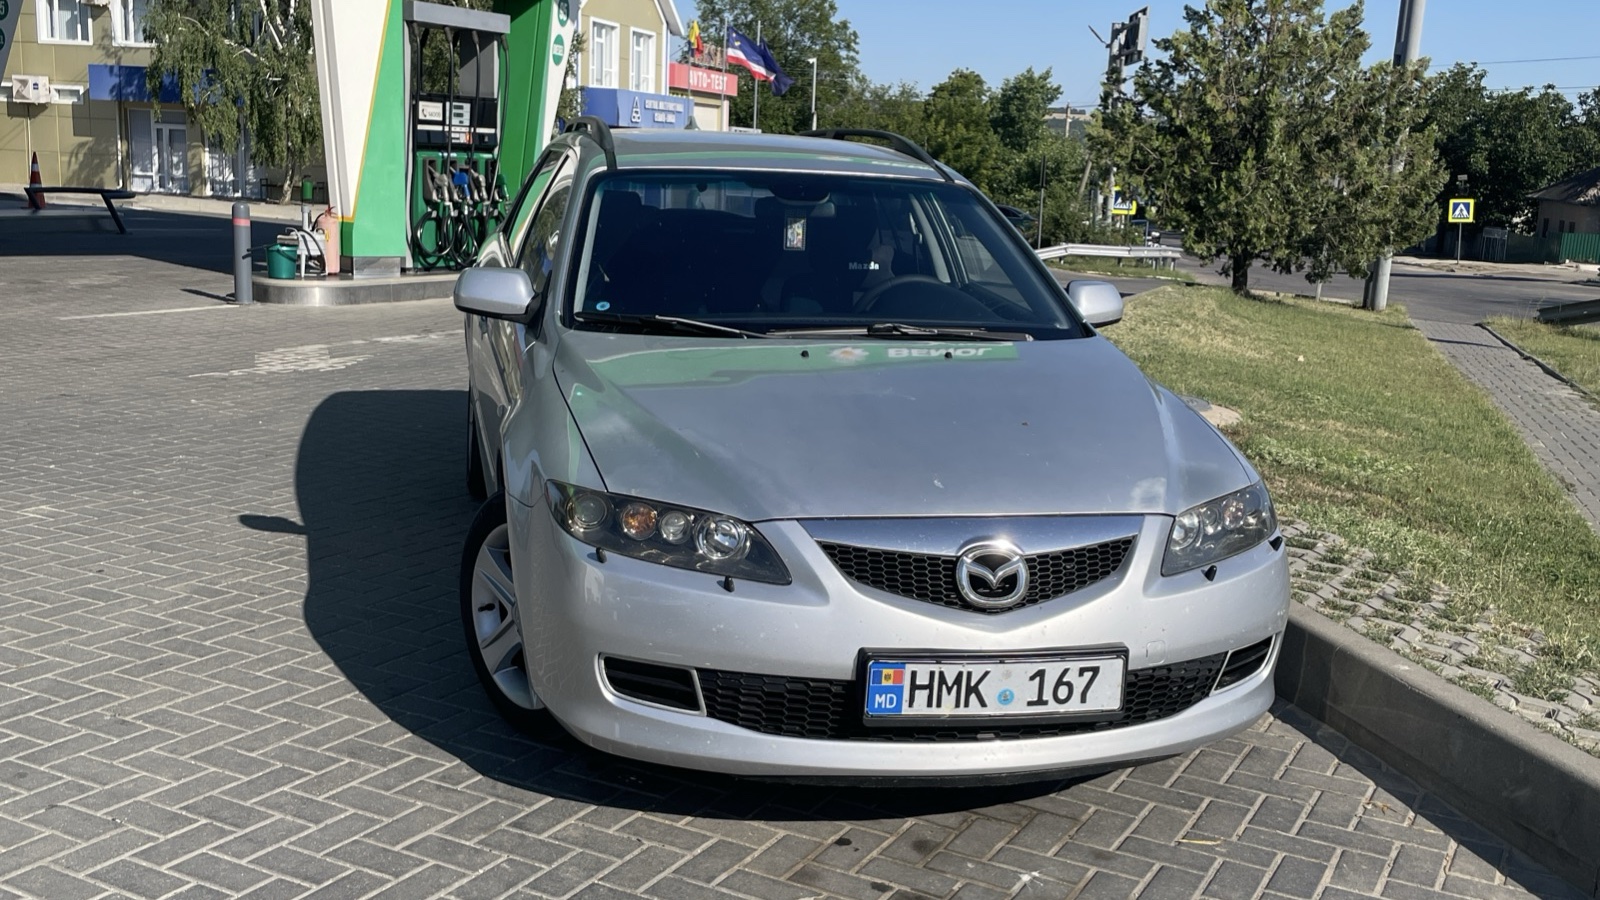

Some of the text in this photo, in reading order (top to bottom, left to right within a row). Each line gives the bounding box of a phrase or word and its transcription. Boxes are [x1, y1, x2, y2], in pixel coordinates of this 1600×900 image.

[689, 69, 728, 91] AVTO-TEST
[848, 261, 880, 270] Mazda
[908, 665, 1101, 708] HMK 167
[874, 693, 897, 709] MD
